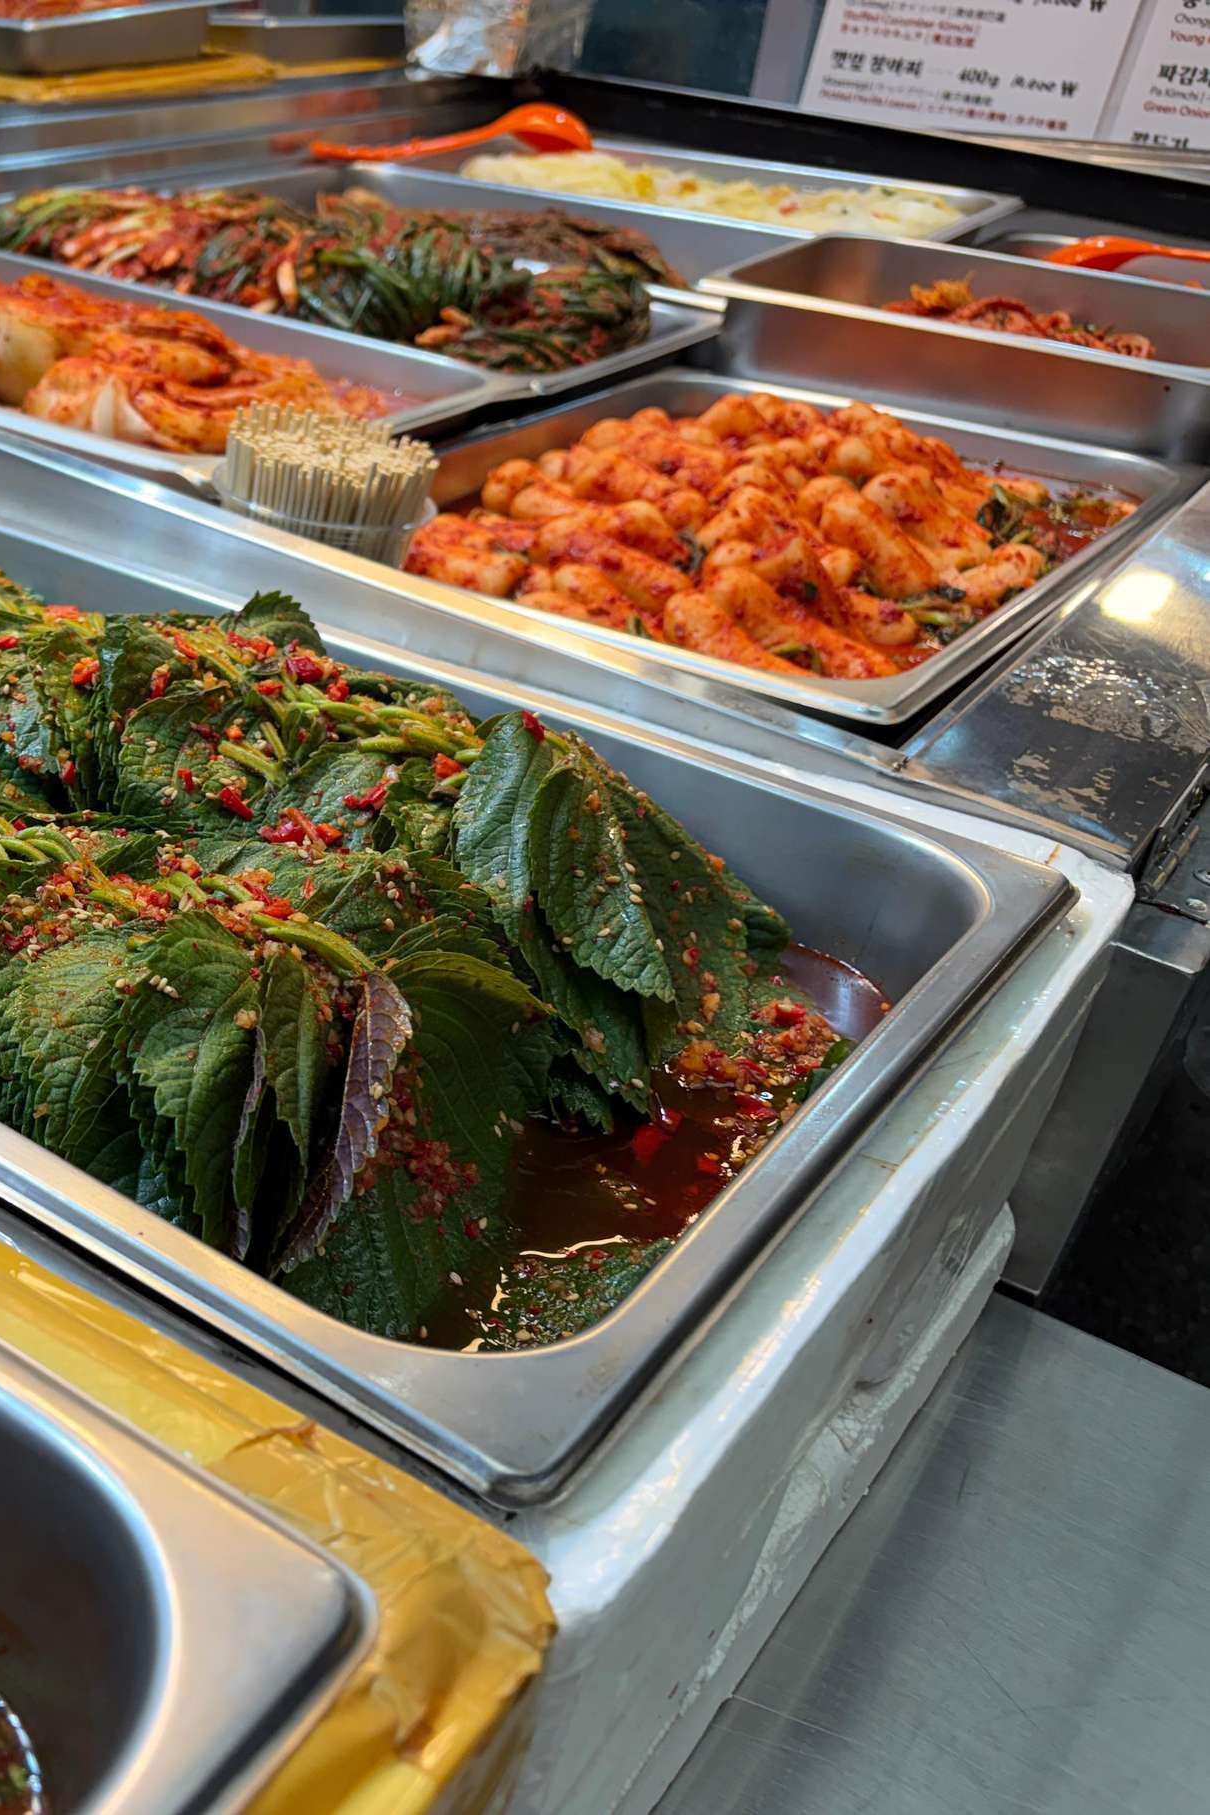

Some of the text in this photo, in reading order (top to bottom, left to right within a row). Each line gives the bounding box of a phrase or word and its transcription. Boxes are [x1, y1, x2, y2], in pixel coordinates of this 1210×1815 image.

[1170, 29, 1206, 48] Young
[1165, 87, 1199, 101] Kimchi
[1143, 100, 1177, 114] Green
